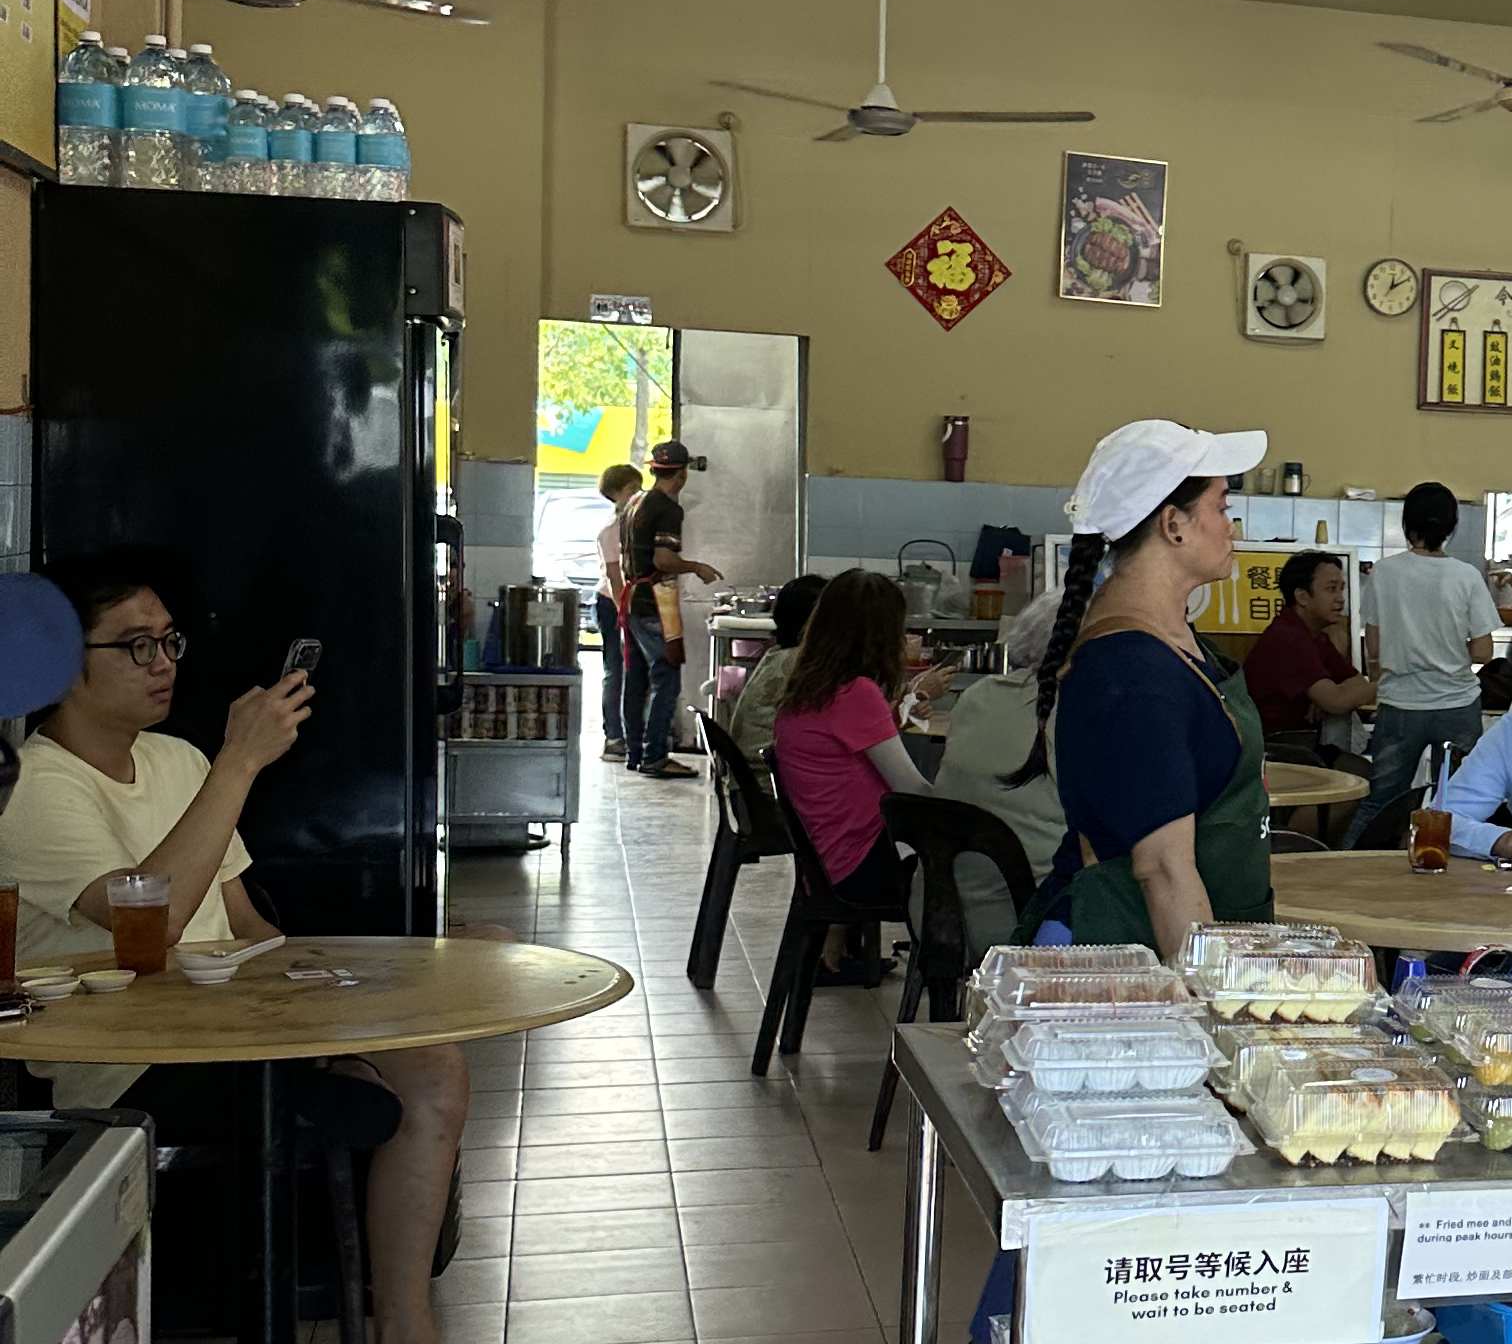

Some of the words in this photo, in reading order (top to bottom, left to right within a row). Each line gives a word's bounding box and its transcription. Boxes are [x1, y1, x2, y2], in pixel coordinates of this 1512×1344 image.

[927, 239, 976, 291] 福
[1436, 1218, 1463, 1230] Fried
[1466, 1219, 1489, 1229] mee
[1491, 1217, 1512, 1228] and
[1417, 1233, 1452, 1244] during
[1455, 1231, 1481, 1243] peak
[1104, 1247, 1311, 1285] 请取号等候入座
[1113, 1289, 1169, 1304] Please
[1174, 1285, 1210, 1300] take
[1215, 1281, 1278, 1298] number
[1282, 1280, 1293, 1293] &
[1131, 1304, 1168, 1320] wait
[1173, 1304, 1189, 1317] to
[1194, 1301, 1215, 1316] be
[1219, 1297, 1277, 1314] seated
